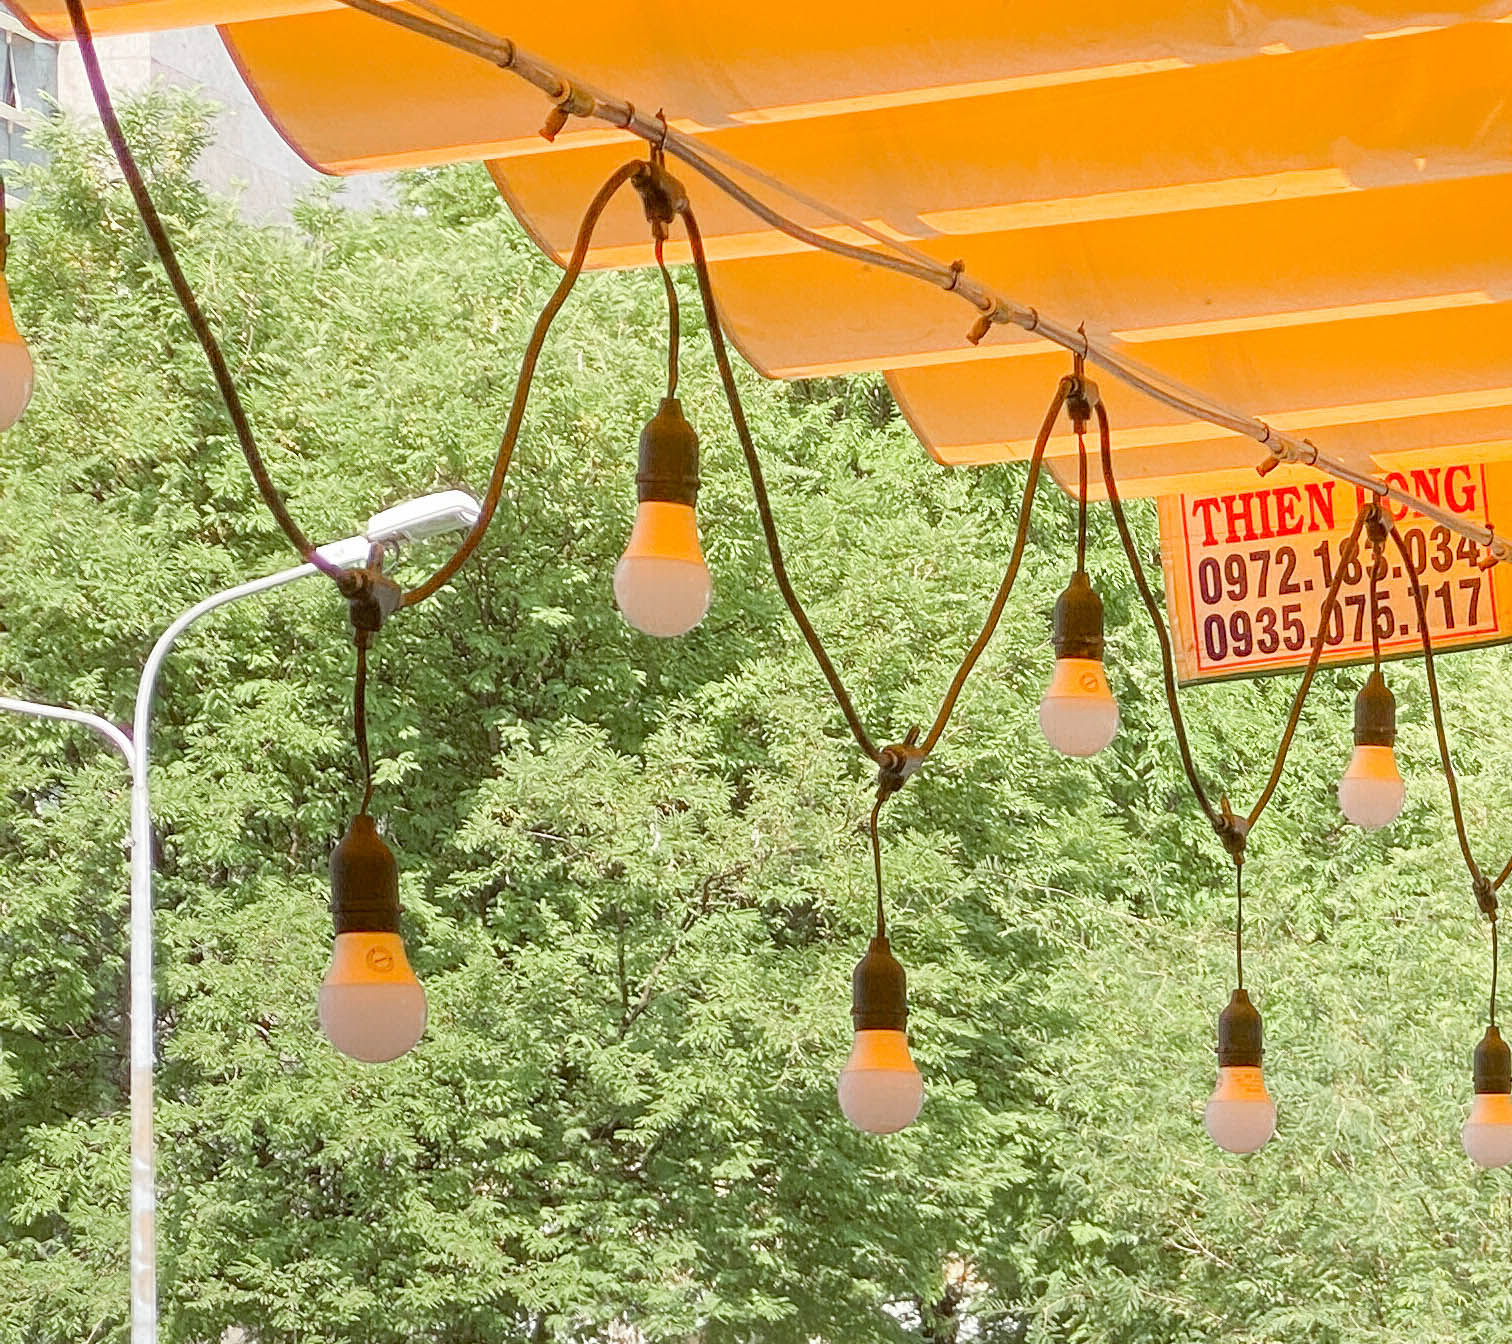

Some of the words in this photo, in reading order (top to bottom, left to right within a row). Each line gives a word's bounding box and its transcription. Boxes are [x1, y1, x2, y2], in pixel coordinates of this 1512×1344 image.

[1193, 482, 1336, 547] THIEN
[1199, 525, 1481, 606] 0972.183.034
[1204, 577, 1482, 661] 0935.075.717
